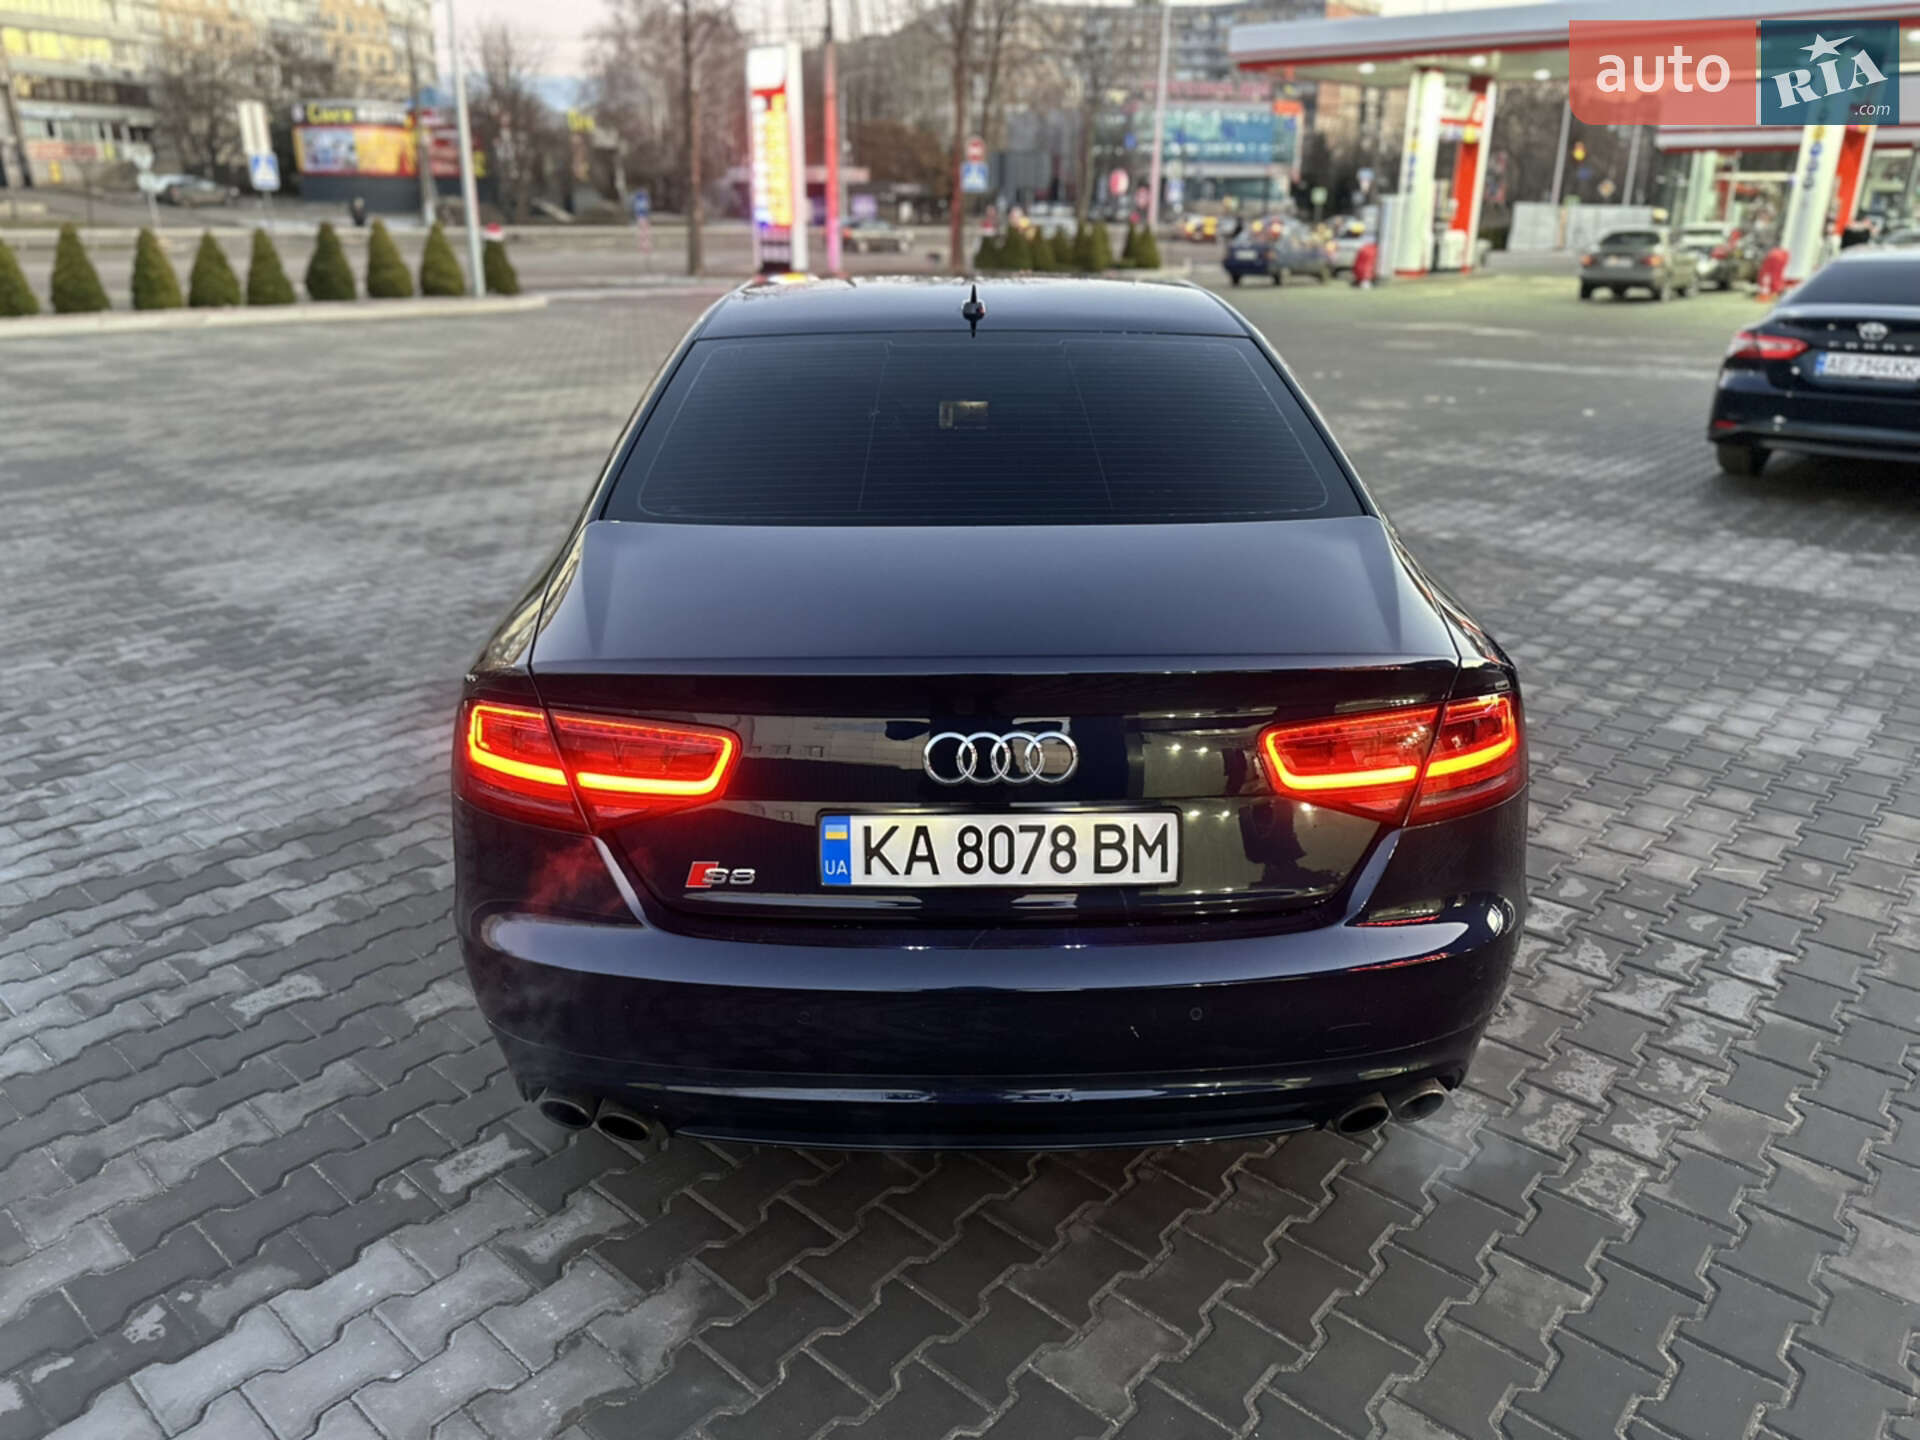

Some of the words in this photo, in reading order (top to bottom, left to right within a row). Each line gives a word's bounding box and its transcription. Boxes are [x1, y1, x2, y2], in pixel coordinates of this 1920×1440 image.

[864, 824, 940, 876] KA
[956, 824, 1077, 876] 8078
[1093, 823, 1169, 875] BM
[702, 867, 756, 885] S8
[824, 860, 848, 875] UA
